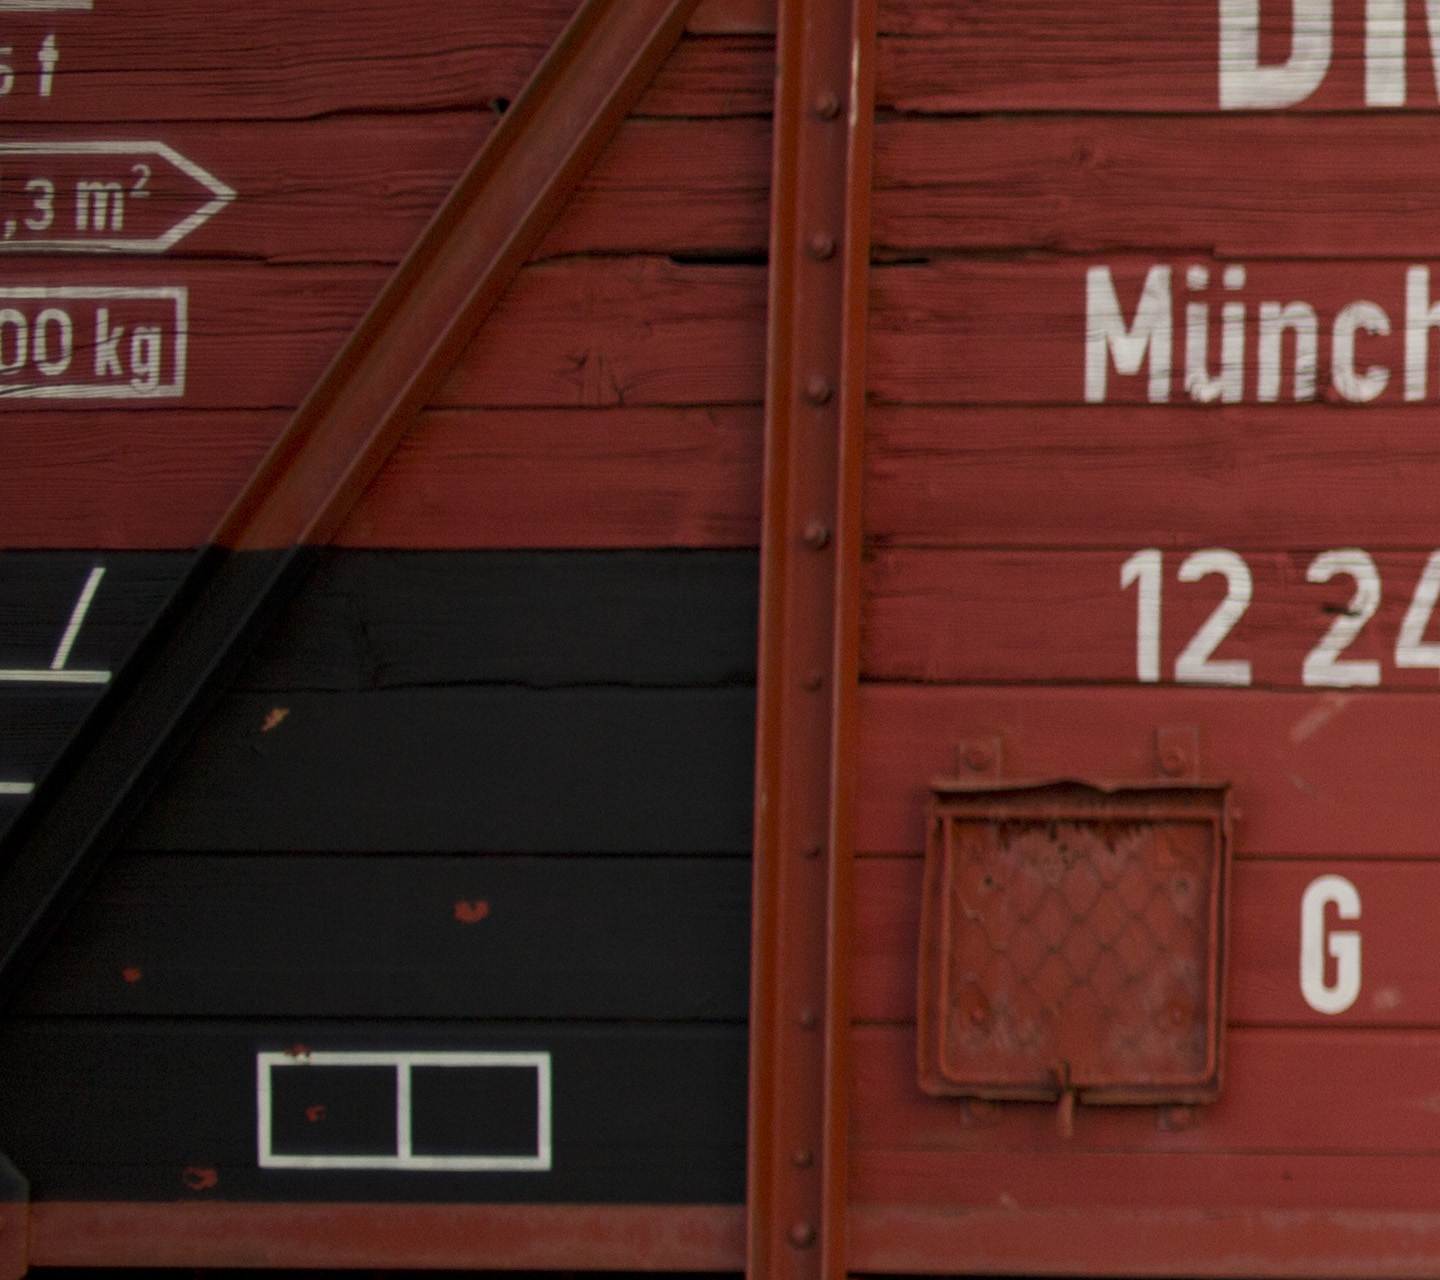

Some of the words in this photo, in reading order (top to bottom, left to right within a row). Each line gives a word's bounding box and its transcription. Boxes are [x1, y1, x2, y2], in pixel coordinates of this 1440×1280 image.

[94, 307, 162, 393] kg
[1120, 549, 1253, 685] 12
[1300, 874, 1361, 1015] G
